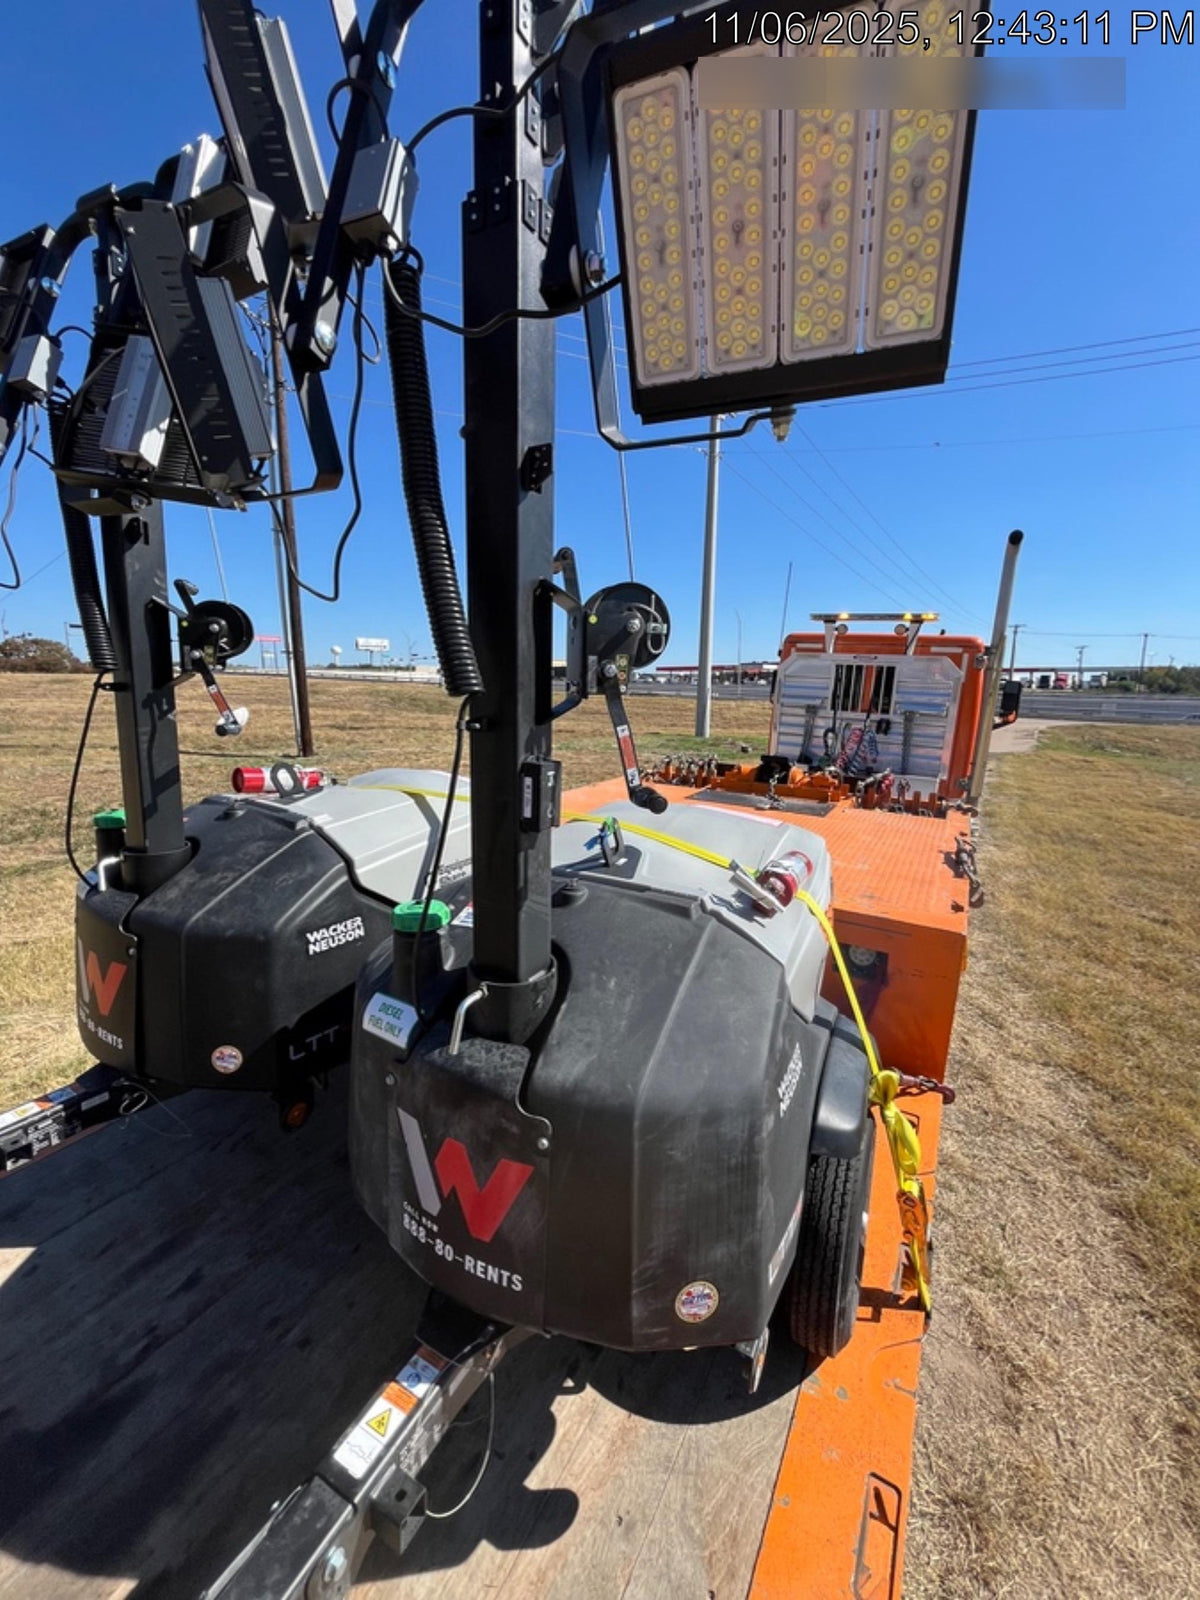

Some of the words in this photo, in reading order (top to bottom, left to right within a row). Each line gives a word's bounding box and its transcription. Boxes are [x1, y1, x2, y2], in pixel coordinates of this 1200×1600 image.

[305, 916, 363, 943] WACKER
[308, 925, 365, 956] NEUSON
[378, 1002, 405, 1021] DIESEL
[403, 1213, 524, 1292] 888-80-RENTS
